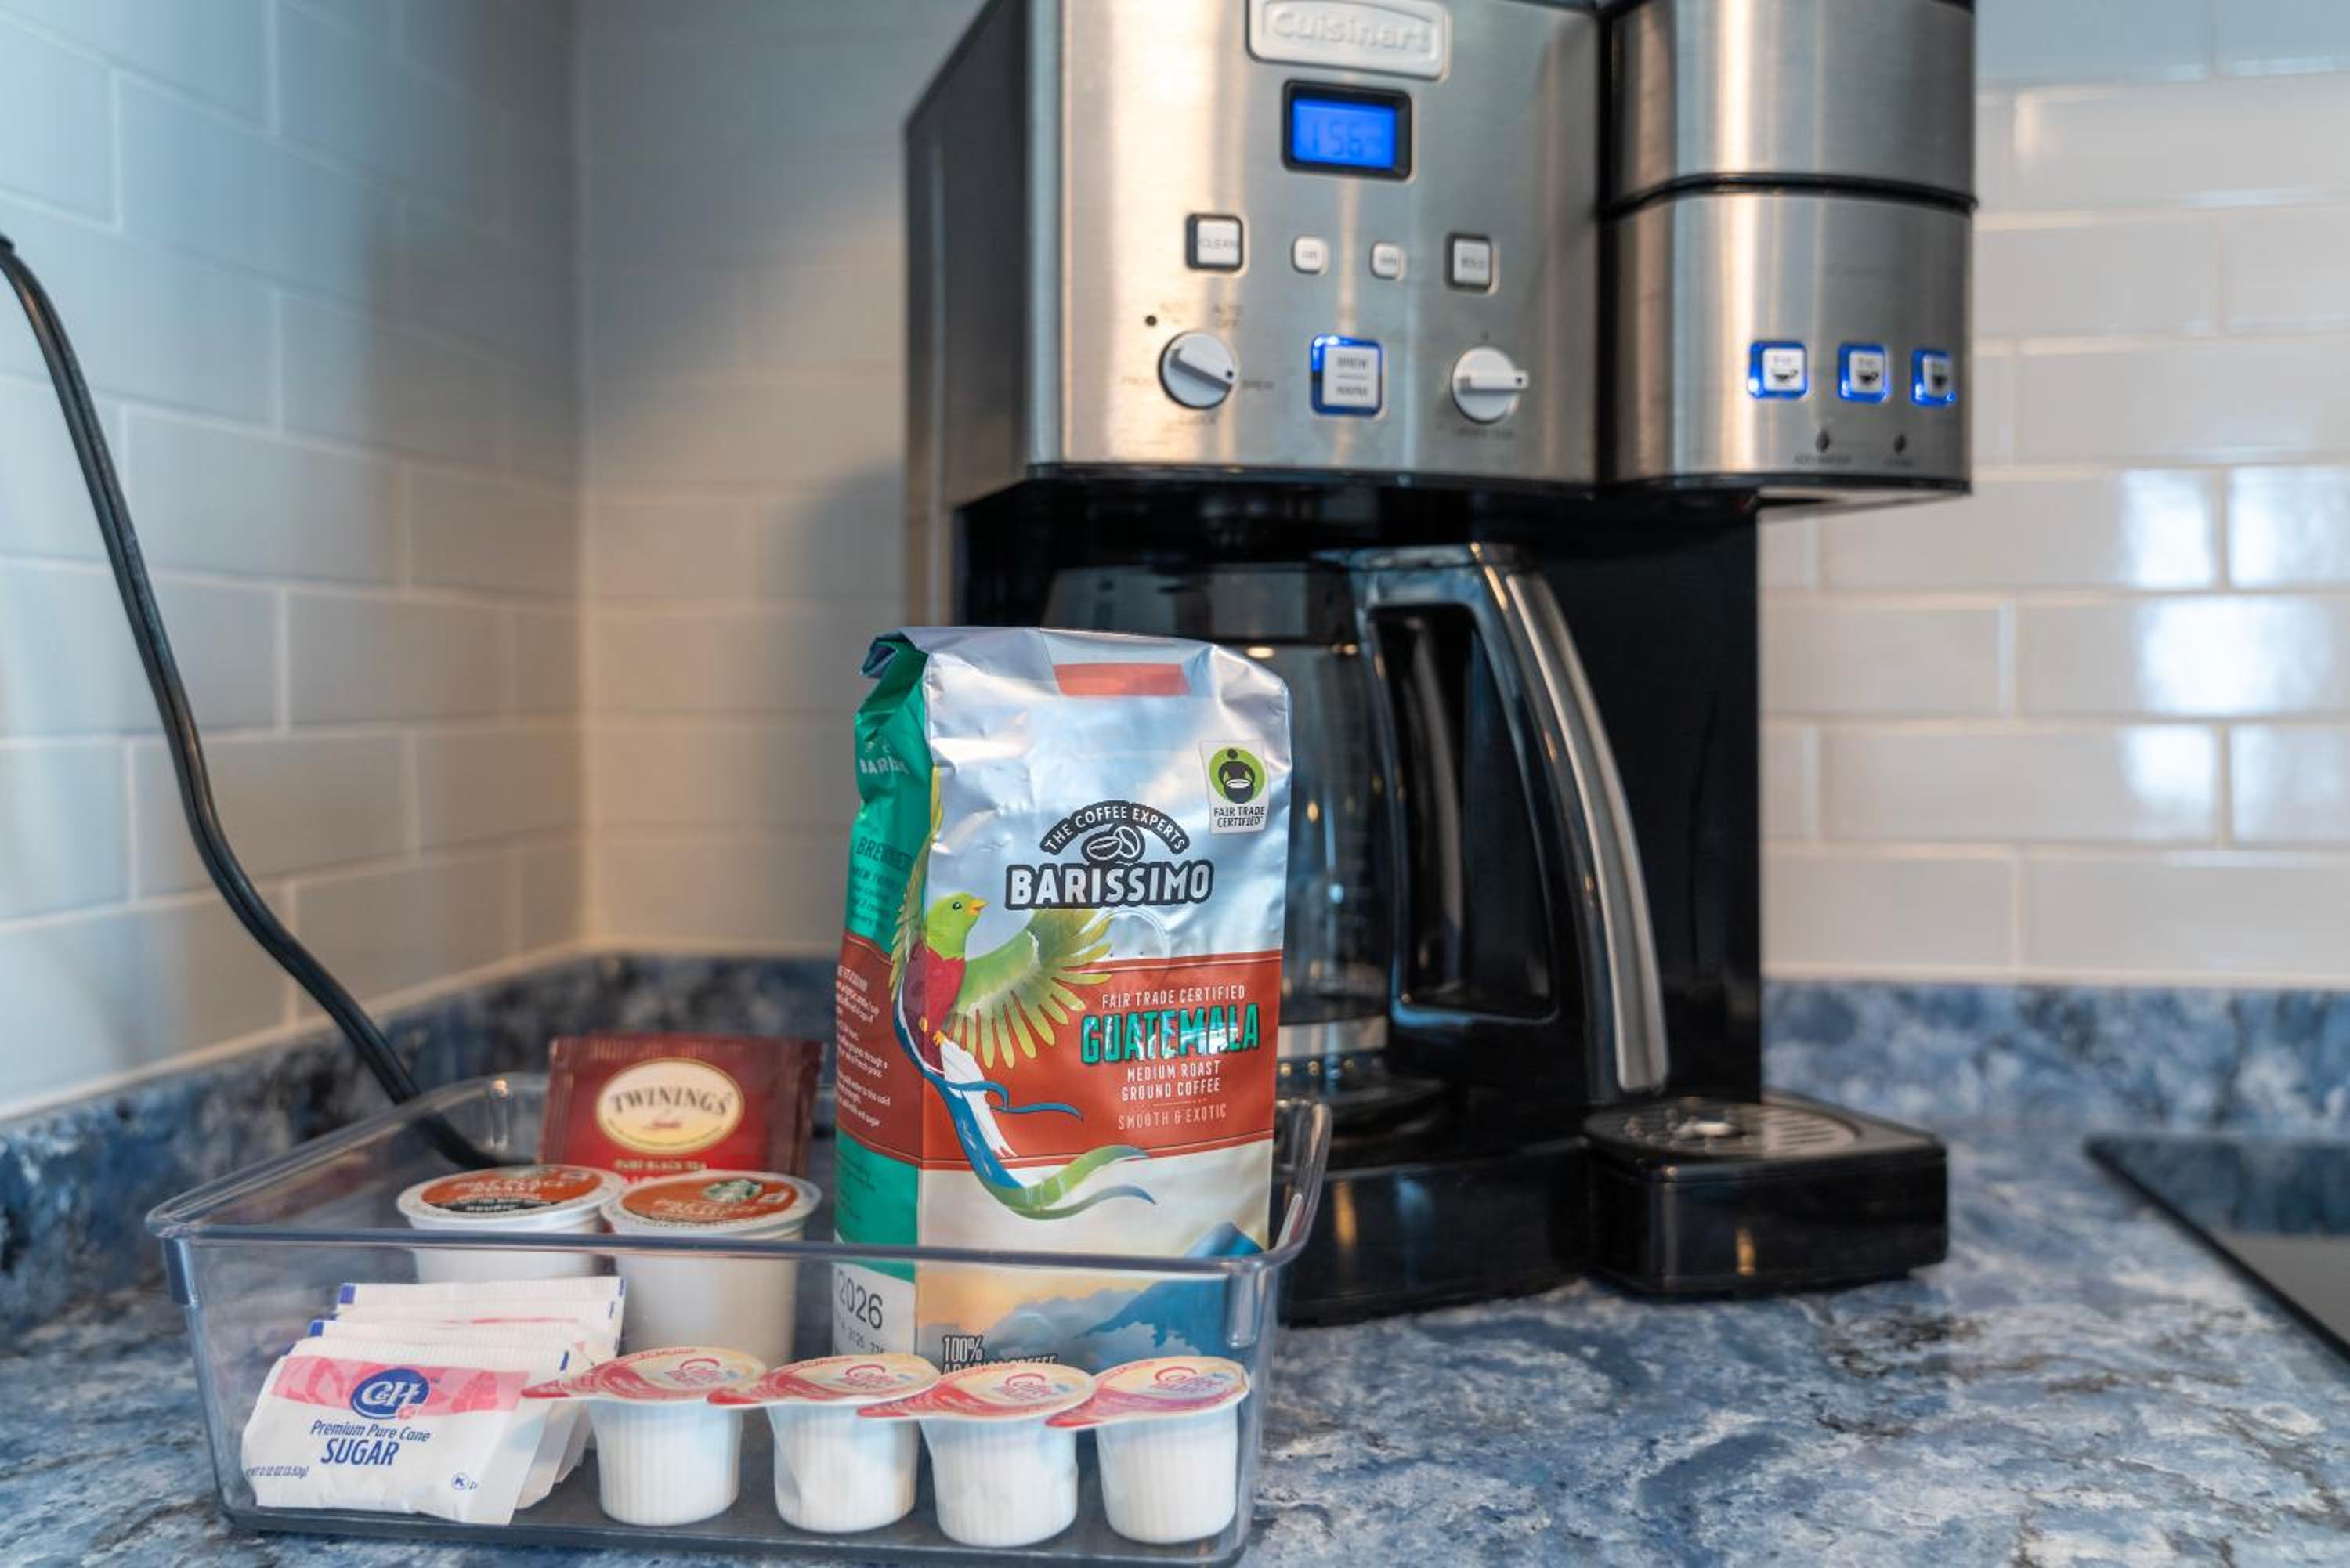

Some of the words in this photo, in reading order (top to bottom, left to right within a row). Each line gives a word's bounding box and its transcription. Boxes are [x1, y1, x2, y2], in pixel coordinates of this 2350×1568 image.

[1272, 9, 1430, 53] Cuisinart
[1213, 807, 1236, 818] FAIR
[1238, 805, 1266, 817] TRADE
[1045, 823, 1073, 851] THE
[1075, 805, 1128, 829] COFFEE
[1131, 807, 1187, 851] EXPERTS
[1009, 862, 1211, 906] BARISSIMO
[1102, 993, 1134, 1009] FAIR
[1136, 989, 1175, 1006] TRADE
[1179, 985, 1246, 1003] CERTIFIED
[1081, 1003, 1260, 1064] GUATEMALA
[1127, 1065, 1175, 1083] MEDIUM
[1180, 1060, 1221, 1077] ROAST
[610, 1086, 727, 1116] TWININGS
[1122, 1084, 1171, 1102] GROUND
[1177, 1078, 1220, 1097] COFFEE
[1118, 1111, 1169, 1130] SMOOTH
[1174, 1111, 1181, 1124] &
[1185, 1104, 1227, 1123] EXOTIC
[837, 1268, 883, 1330] 2026
[943, 1335, 985, 1364] 100%
[310, 1419, 366, 1437] Premium
[366, 1423, 397, 1439] Pure
[400, 1425, 431, 1443] Cane
[321, 1437, 400, 1466] SUGAR
